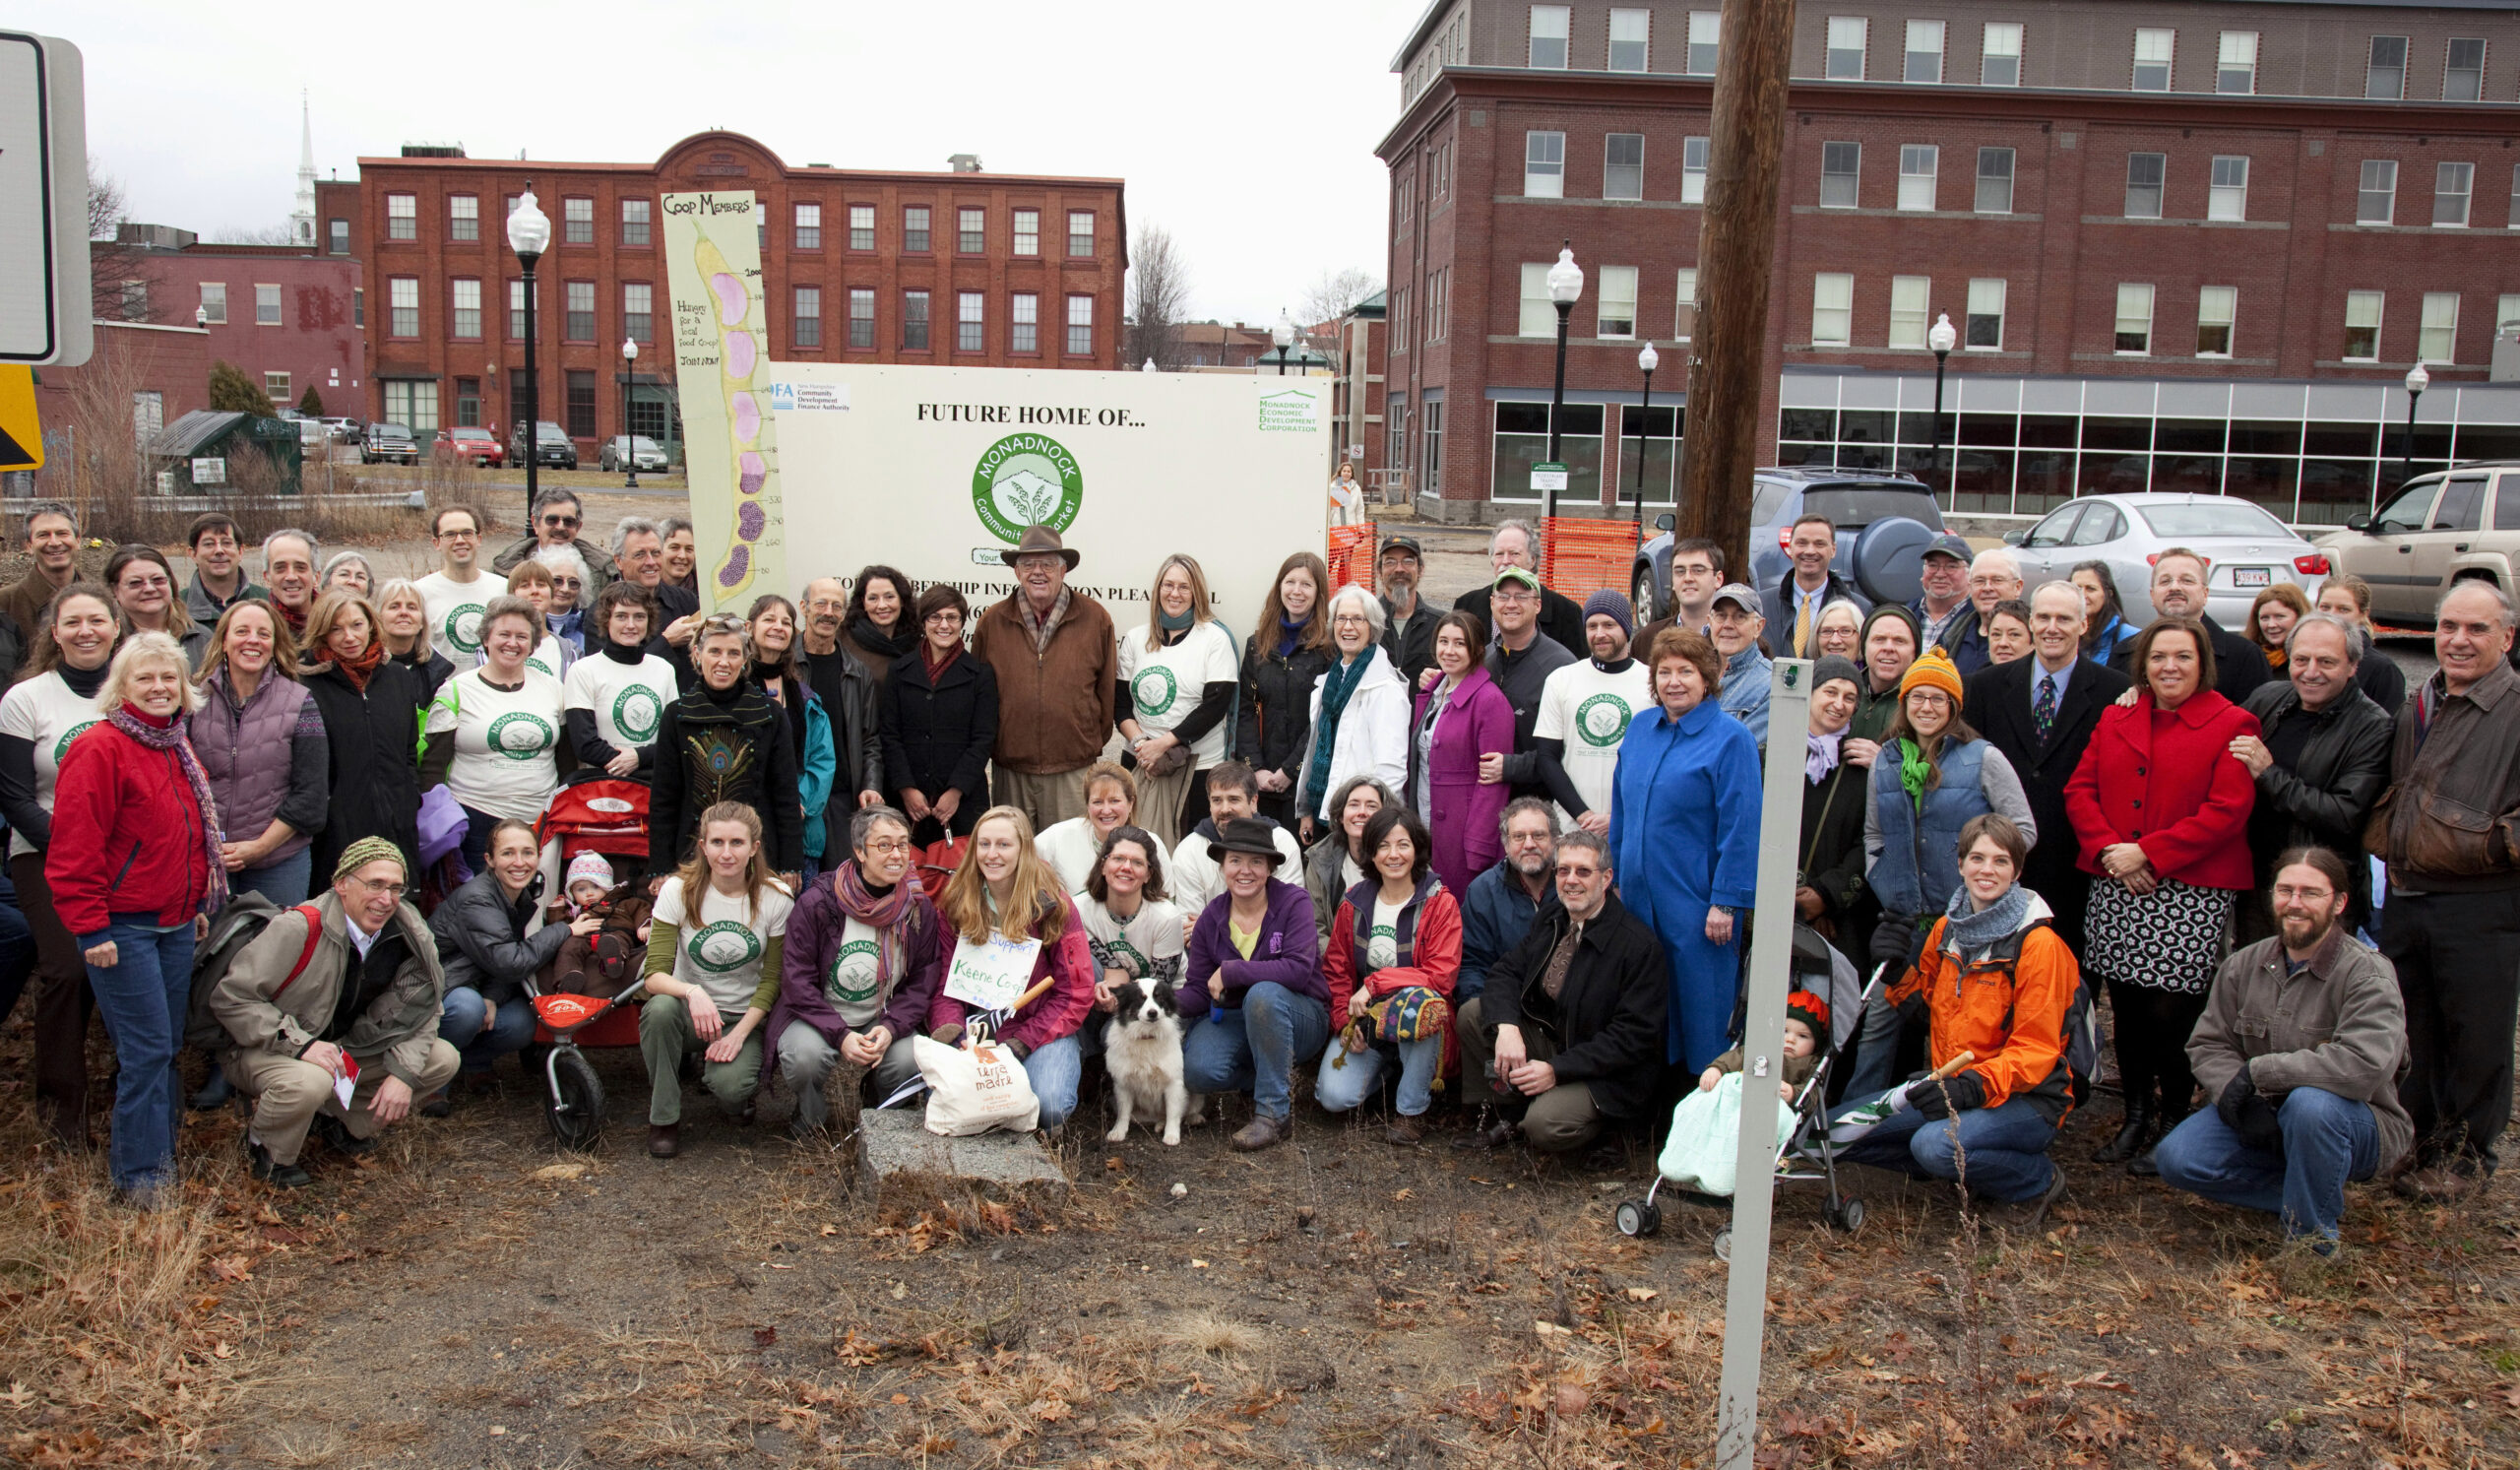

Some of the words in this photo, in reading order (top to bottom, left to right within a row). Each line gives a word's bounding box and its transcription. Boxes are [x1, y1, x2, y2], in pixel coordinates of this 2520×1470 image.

[677, 299, 707, 315] Hungry
[679, 316, 691, 326] for
[681, 327, 698, 336] local
[823, 405, 850, 414] Authority
[1260, 400, 1311, 410] MONADNOCK
[1260, 409, 1304, 417] ECONOMIC
[917, 403, 1011, 423] FUTURE
[1019, 406, 1091, 426] HOME
[1098, 409, 1146, 428] OF...
[1259, 416, 1317, 425] DEVELOPMENT
[1258, 423, 1318, 433] CORPORATION
[977, 436, 1077, 479] MONADNOCK
[769, 495, 783, 505] 320
[976, 497, 1022, 542] Communit
[1052, 499, 1076, 532] arket
[978, 552, 999, 563] Your
[1108, 588, 1151, 602] PLEA
[615, 685, 662, 709] MONADNOCK
[1579, 694, 1630, 716] MONADNOCK
[490, 713, 552, 735] MONADNOCK
[695, 922, 759, 948] MONADNOCK
[988, 930, 1035, 955] Support
[954, 959, 993, 984] Keene
[976, 1073, 1013, 1092] madre
